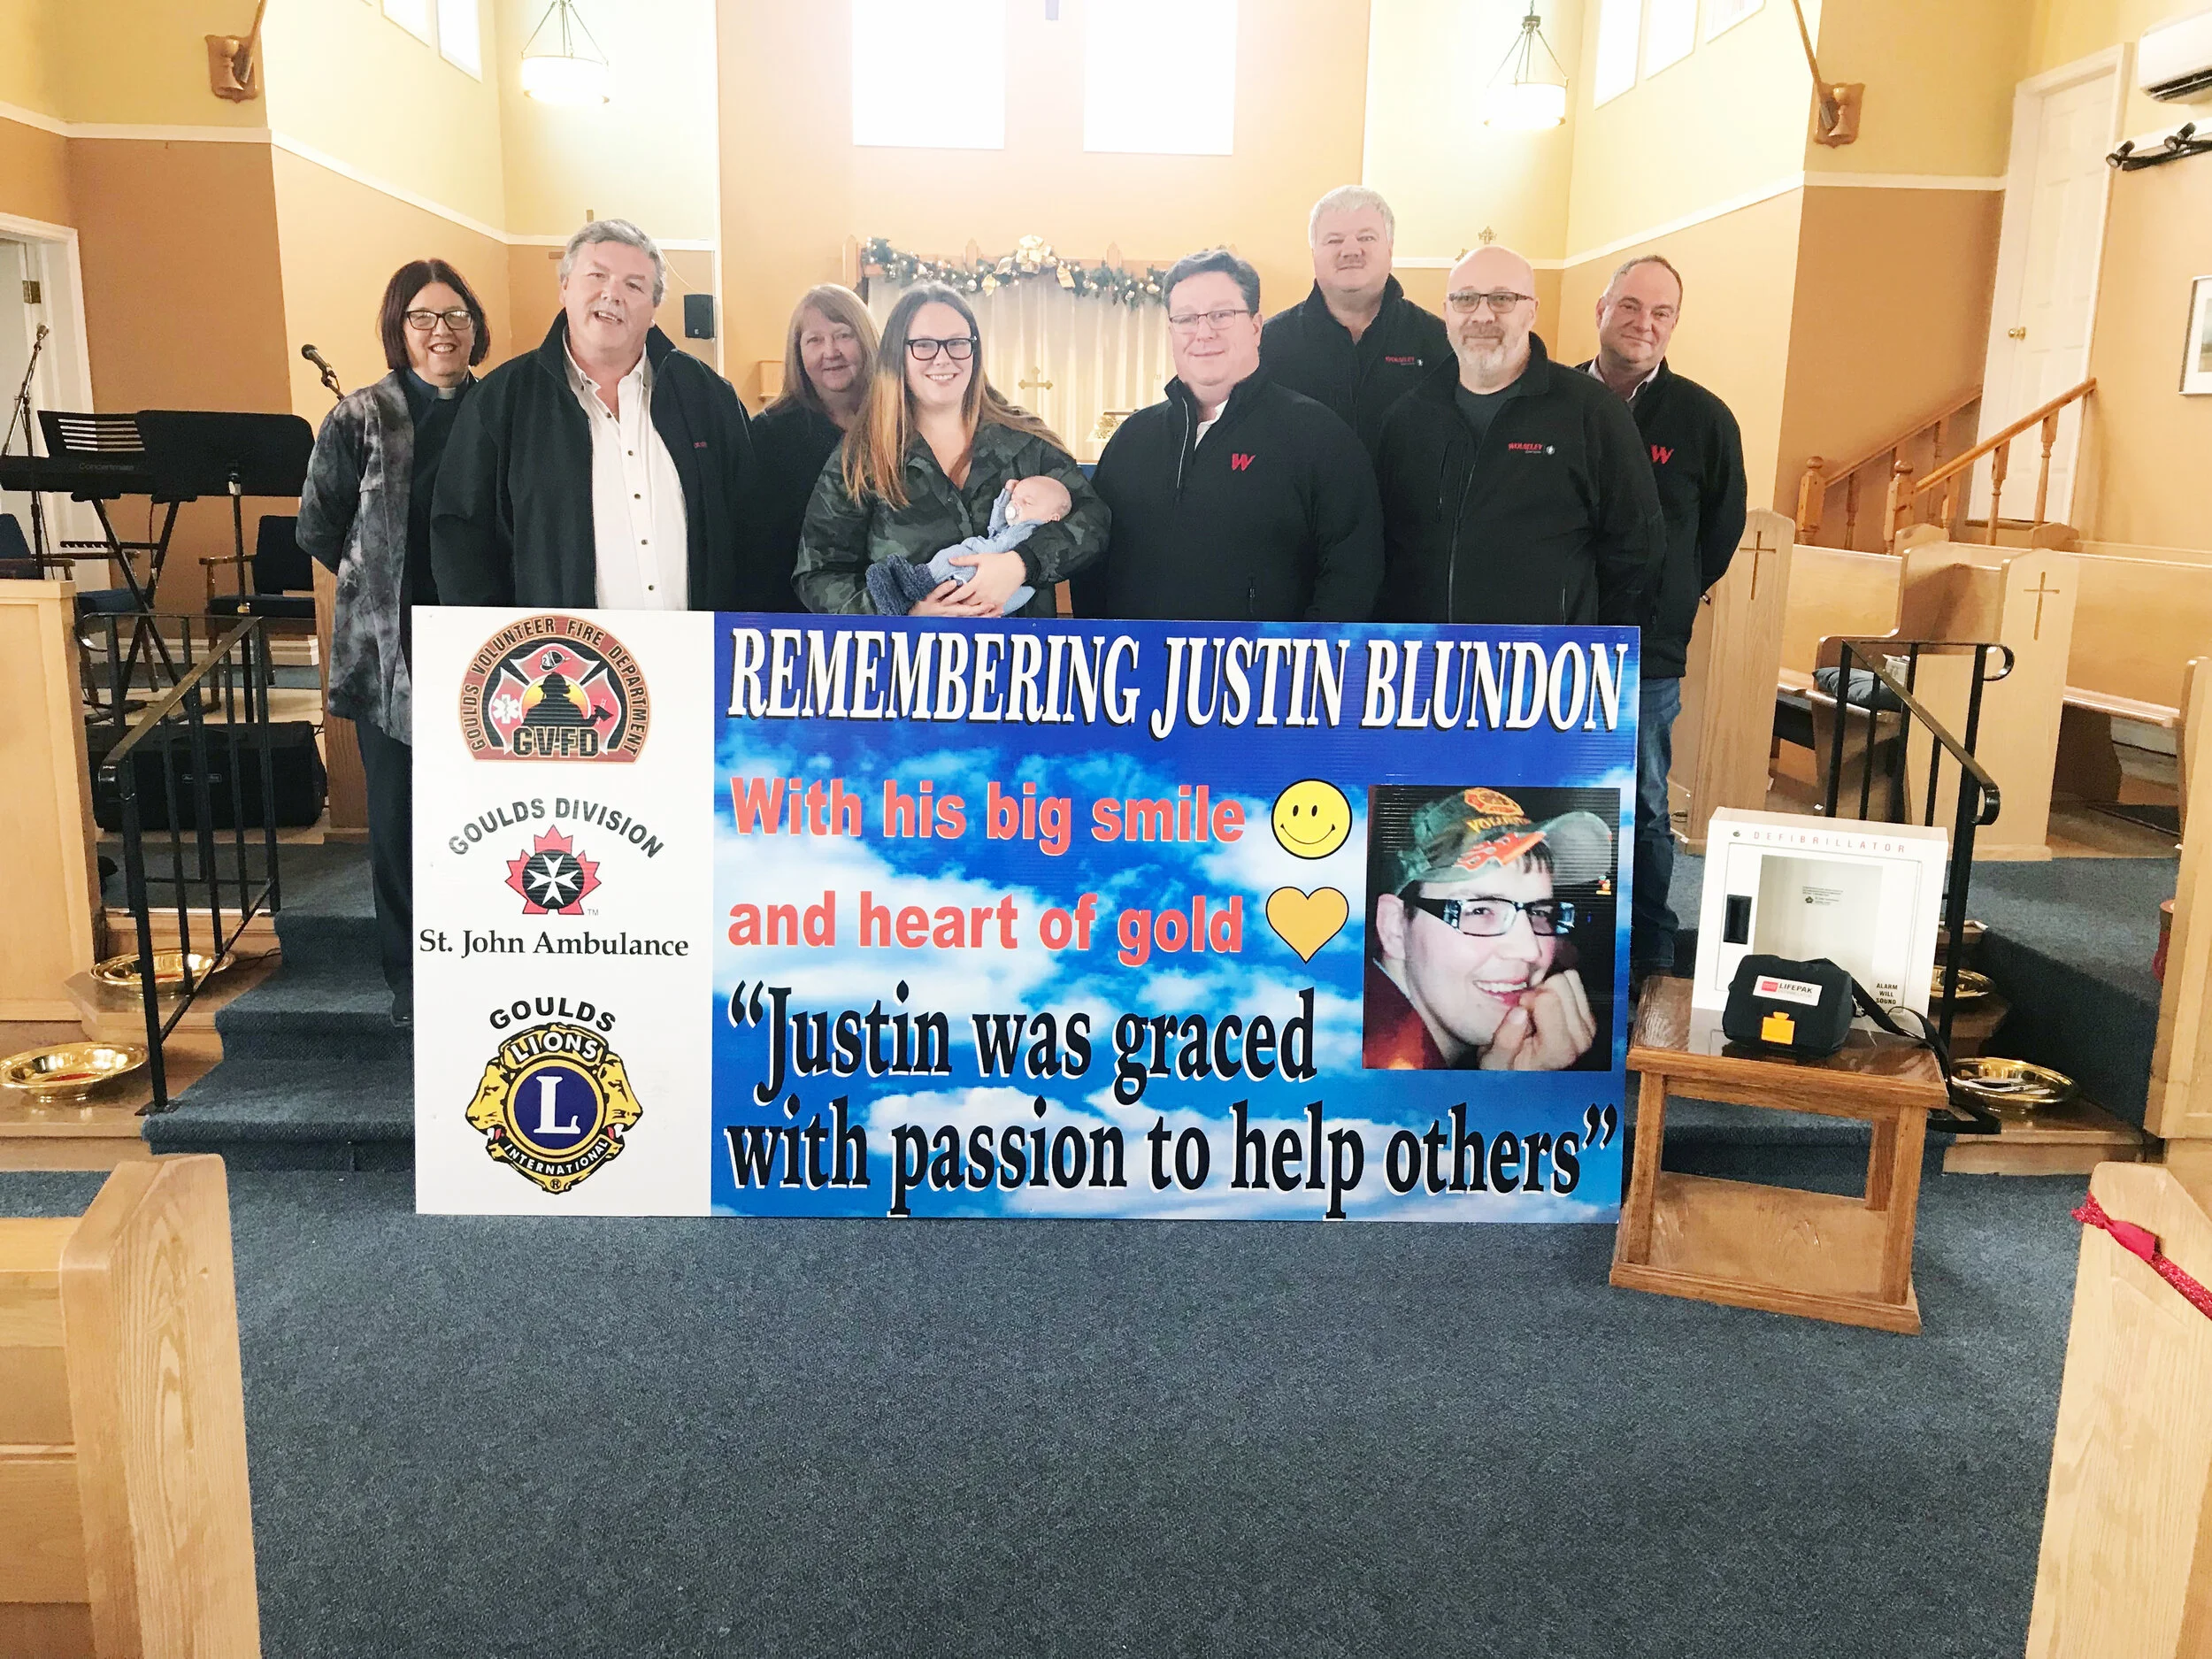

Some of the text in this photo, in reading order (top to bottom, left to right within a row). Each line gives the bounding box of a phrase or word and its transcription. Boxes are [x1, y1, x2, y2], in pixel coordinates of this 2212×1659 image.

[1232, 453, 1256, 471] W
[1650, 444, 1674, 465] W
[460, 618, 649, 756] GOULDS VOLUNTEER FIRE DEPARTMENT
[726, 627, 1629, 740] REMEMBERING JUSTIN BLUNDON
[512, 726, 600, 757] GVFD
[449, 797, 664, 859] GOULDS DIVISION
[730, 777, 1246, 856] With his big smile
[1754, 831, 1905, 853] DEFIBRILLATOR
[419, 928, 689, 958] St. John Ambulance
[727, 890, 1244, 967] and heart of gold
[1778, 982, 1813, 994] LIFEPAK
[489, 996, 617, 1033] GOULDS
[510, 1031, 598, 1063] LIONS
[727, 979, 1317, 1107] “Justin was graced
[533, 1075, 581, 1134] L
[503, 1140, 610, 1175] INTERNATIONAL
[723, 1092, 1617, 1221] with passion to help others”
